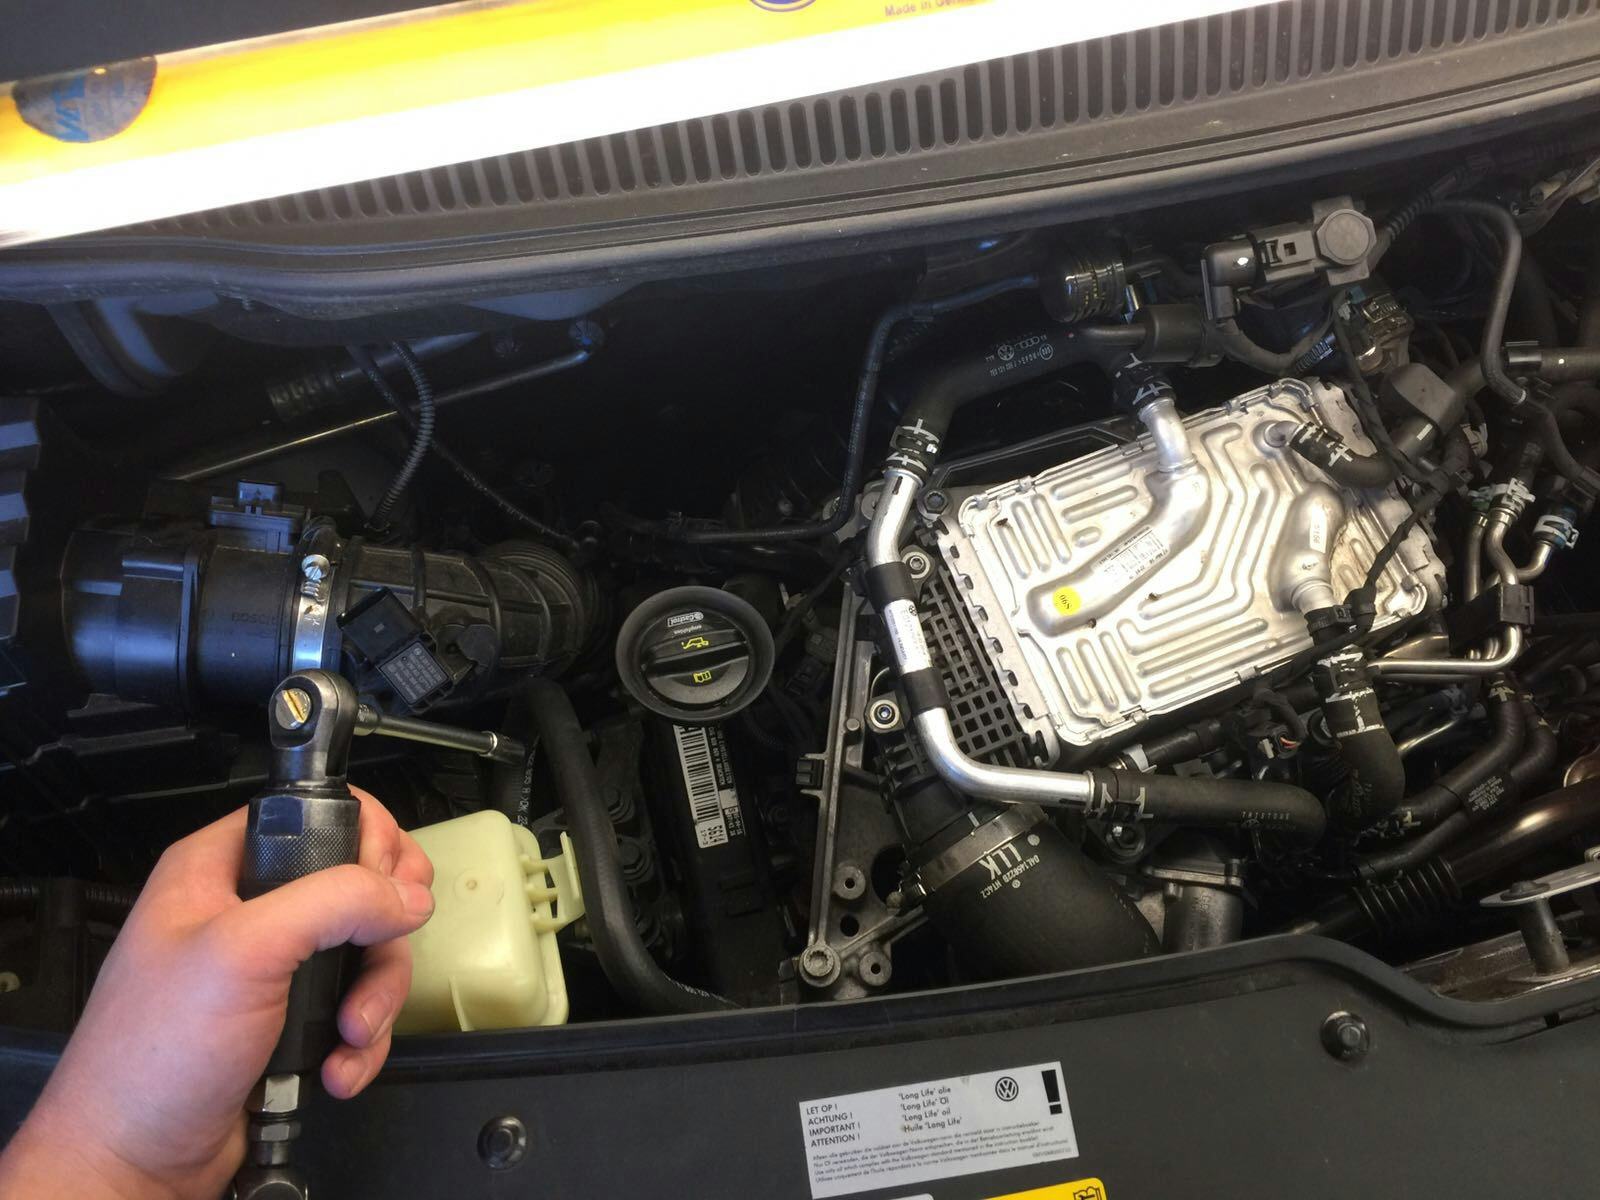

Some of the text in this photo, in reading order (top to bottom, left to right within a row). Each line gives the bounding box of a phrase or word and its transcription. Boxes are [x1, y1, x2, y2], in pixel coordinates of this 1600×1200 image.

[979, 843, 1022, 880] LLK
[938, 1085, 950, 1094] olie
[806, 1106, 818, 1114] LET
[821, 1104, 832, 1112] OP
[808, 1113, 847, 1125] ACHTUNG
[809, 1122, 855, 1136] IMPORTANT
[904, 1123, 922, 1132] Huile
[810, 1133, 854, 1147] ATTENTION
